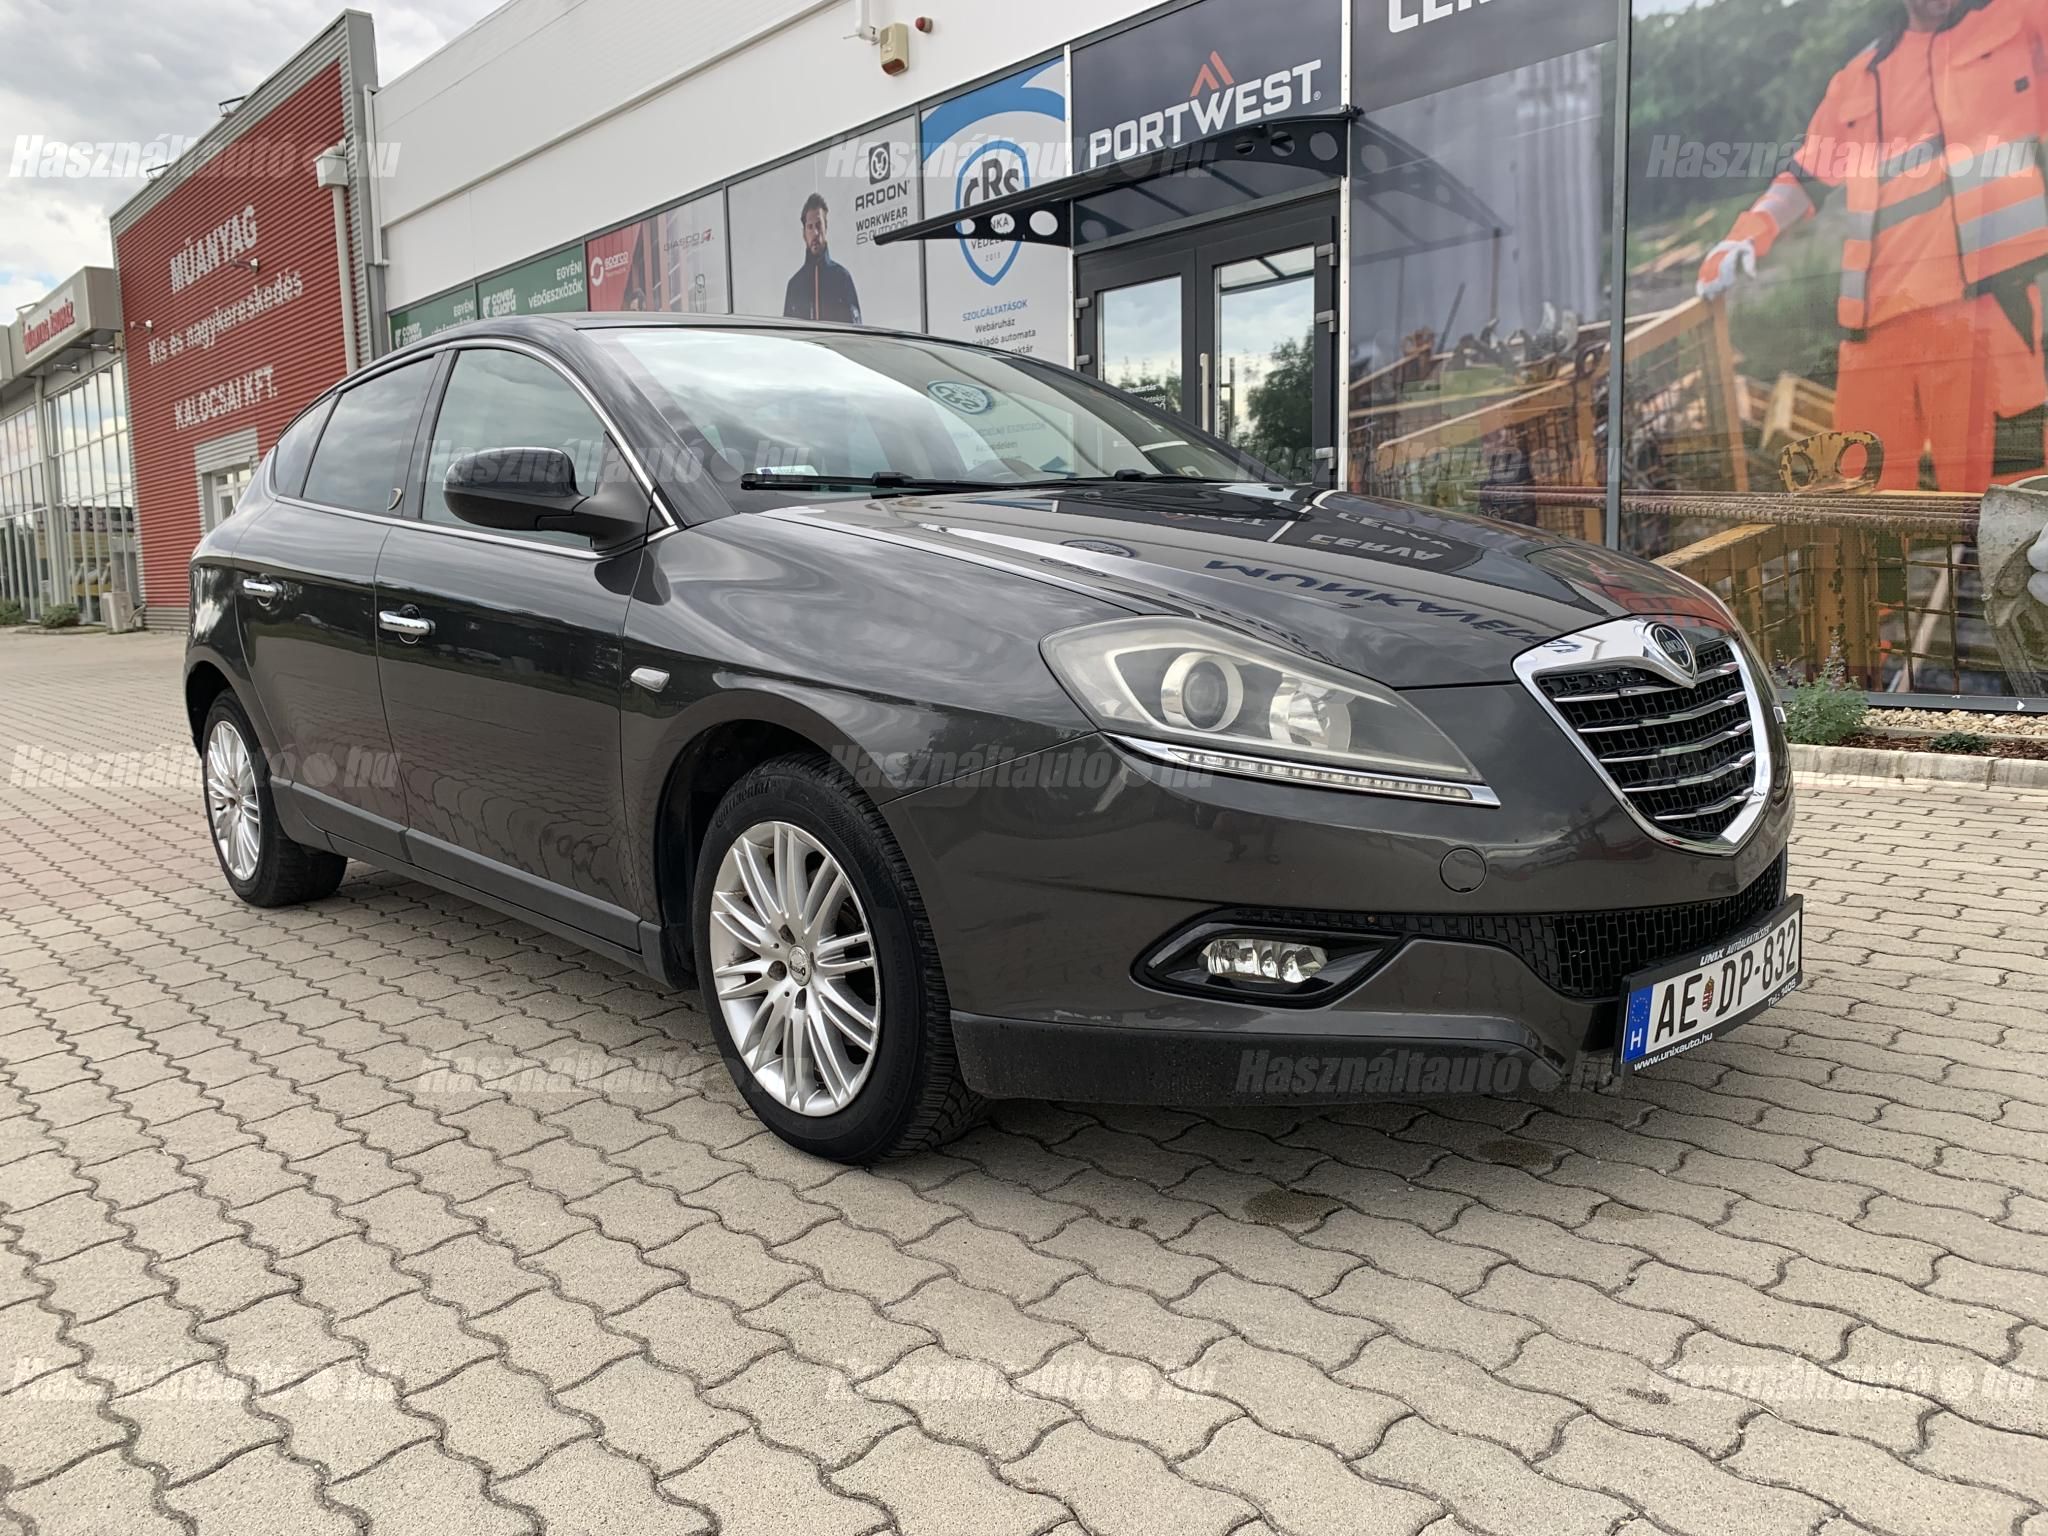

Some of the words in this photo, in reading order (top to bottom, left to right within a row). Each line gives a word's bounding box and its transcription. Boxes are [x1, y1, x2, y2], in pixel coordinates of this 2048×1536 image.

[1089, 59, 1322, 168] PORTWEST
[855, 180, 907, 212] ARDON
[855, 206, 908, 232] WORKWEAR
[556, 260, 583, 280] EGYÉNI
[962, 299, 1028, 322] SZOLGÁLTATÁSOK
[974, 318, 1015, 333] Webáruház
[1000, 329, 1036, 343] automata
[1654, 972, 1703, 1044] AE
[1715, 918, 1797, 1018] DP-832
[1630, 1028, 1642, 1051] H
[1633, 1032, 1713, 1071] www.unixauto.hu
